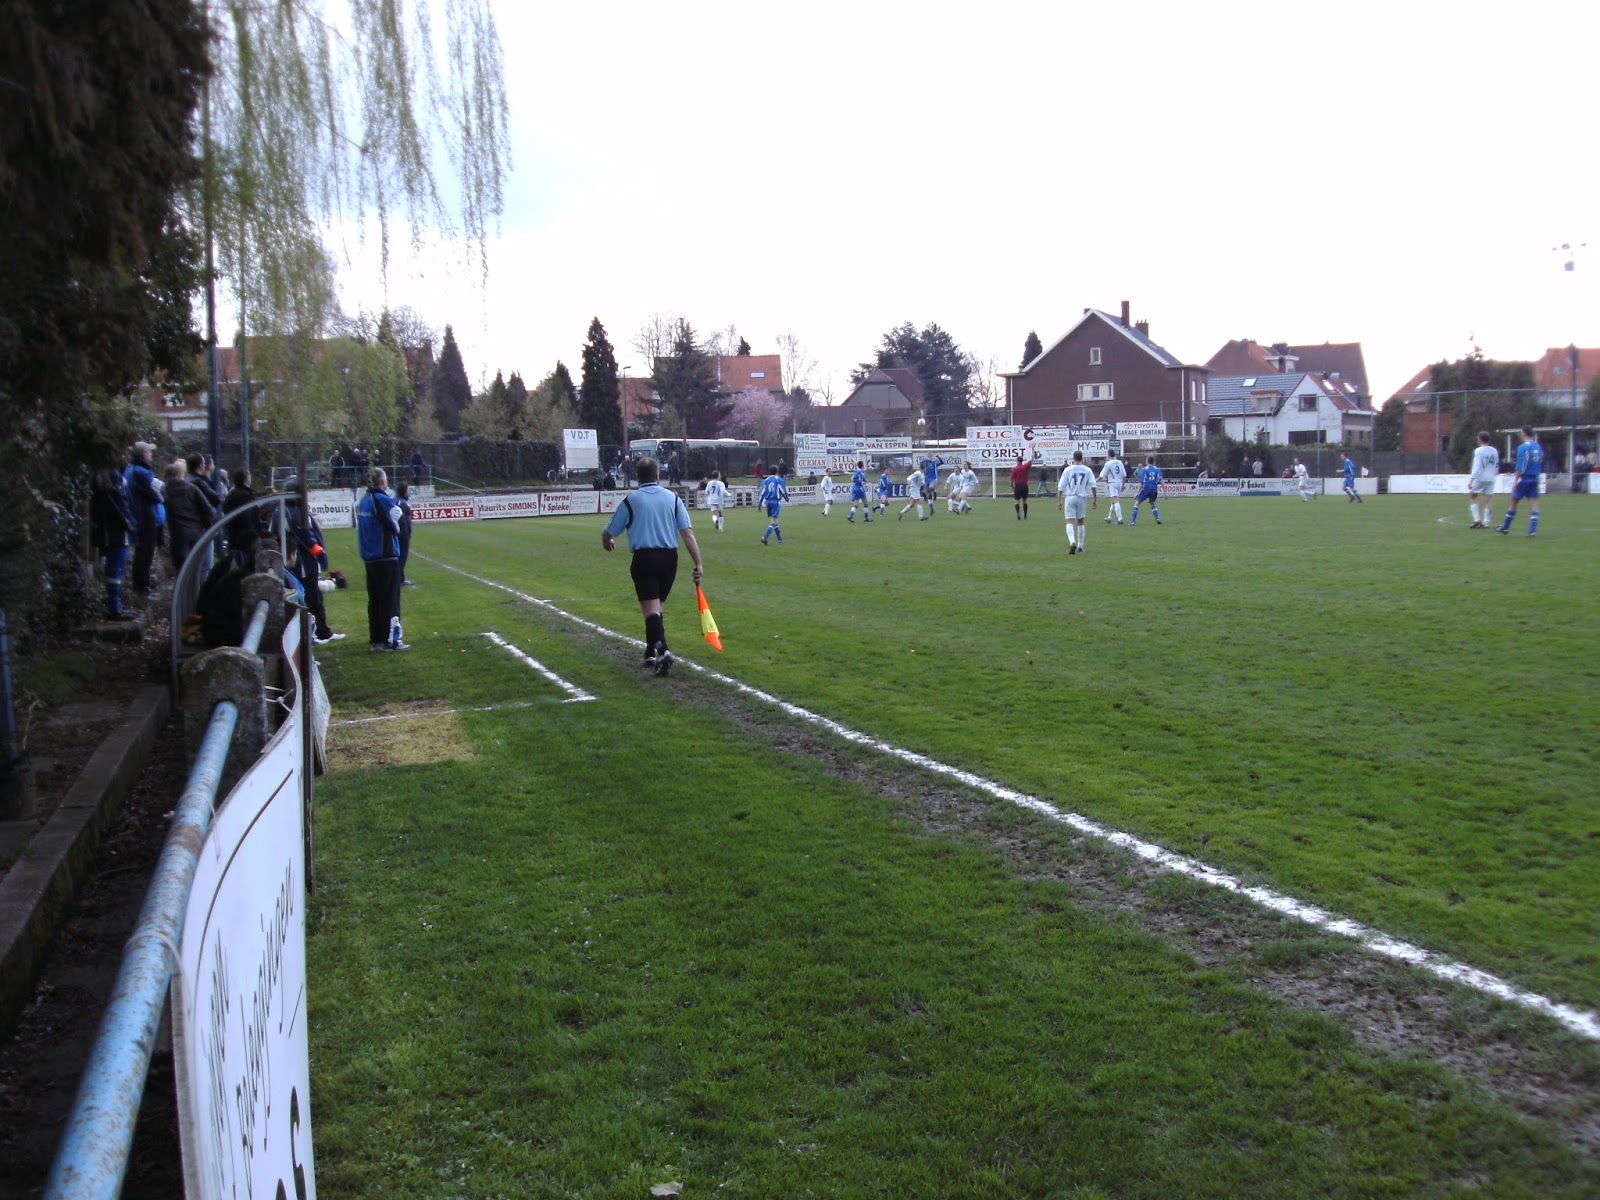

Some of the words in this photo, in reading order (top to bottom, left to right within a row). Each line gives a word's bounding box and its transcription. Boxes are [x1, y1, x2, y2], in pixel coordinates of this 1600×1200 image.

[976, 430, 1012, 439] LUC
[1115, 465, 1120, 475] 9
[1071, 472, 1086, 486] 17
[711, 485, 716, 494] 7
[543, 493, 570, 502] Taverne
[479, 503, 506, 513] Maurits
[507, 501, 537, 511] SIMONS
[547, 502, 570, 513] Spieke
